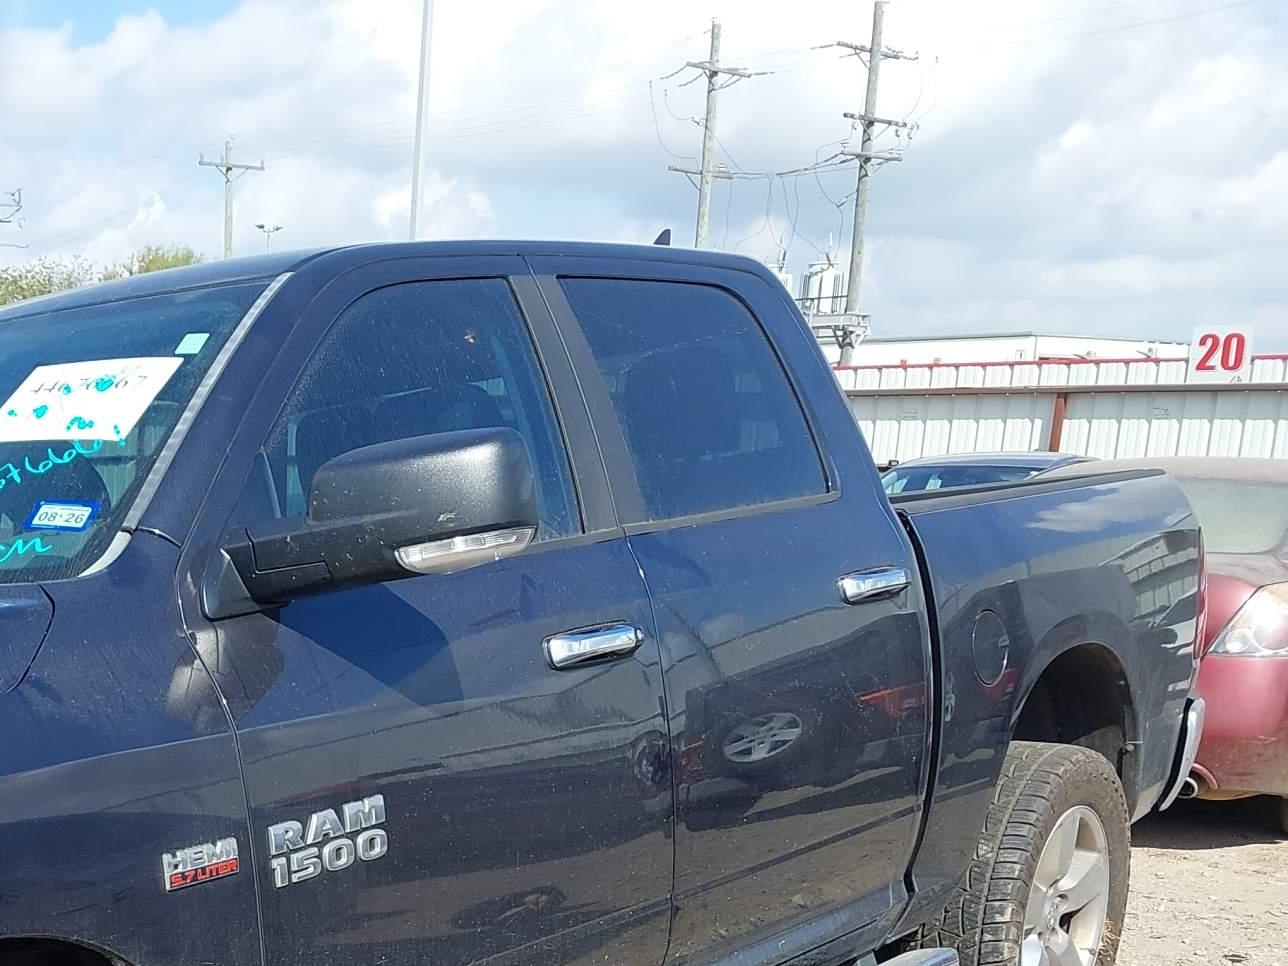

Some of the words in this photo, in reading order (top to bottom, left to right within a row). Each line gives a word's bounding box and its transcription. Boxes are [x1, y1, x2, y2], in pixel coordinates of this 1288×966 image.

[1195, 333, 1246, 372] 20
[267, 794, 387, 855] RAM
[162, 837, 238, 875] HEMI
[170, 870, 196, 887] 5.7
[197, 858, 238, 880] LITER
[271, 828, 389, 888] 1500
